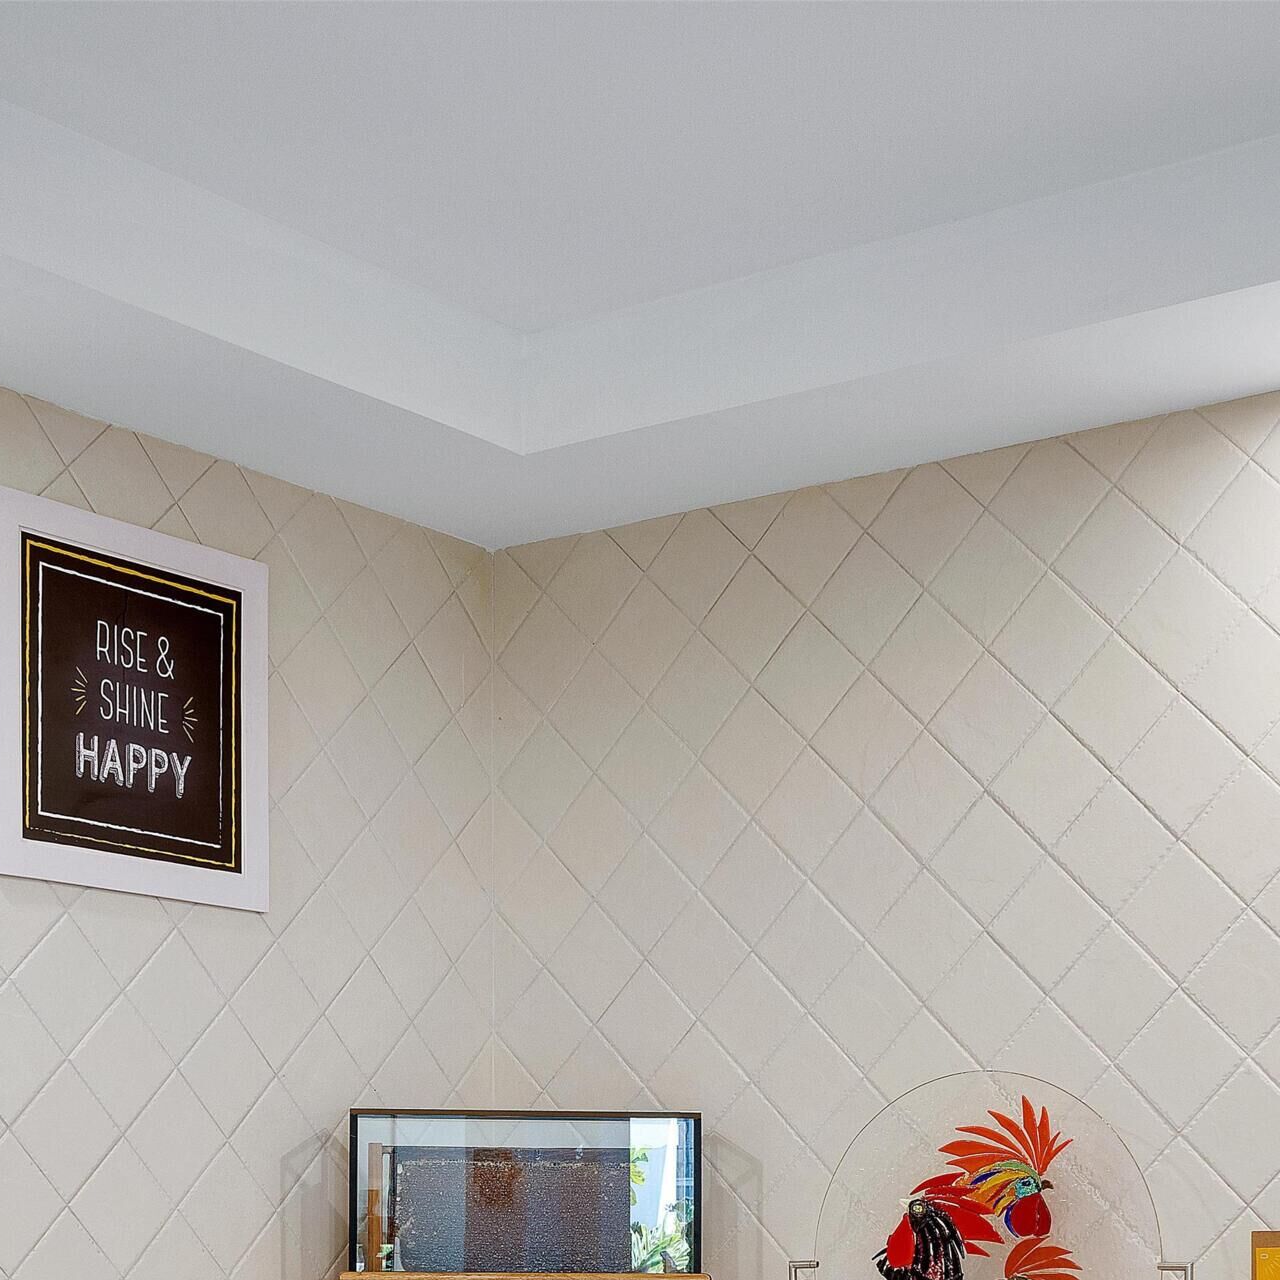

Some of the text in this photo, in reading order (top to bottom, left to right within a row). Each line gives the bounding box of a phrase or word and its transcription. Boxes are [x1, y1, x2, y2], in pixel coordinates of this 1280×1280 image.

[96, 620, 175, 680] RISE &
[99, 679, 170, 734] SHINE
[75, 732, 192, 799] HAPPY
